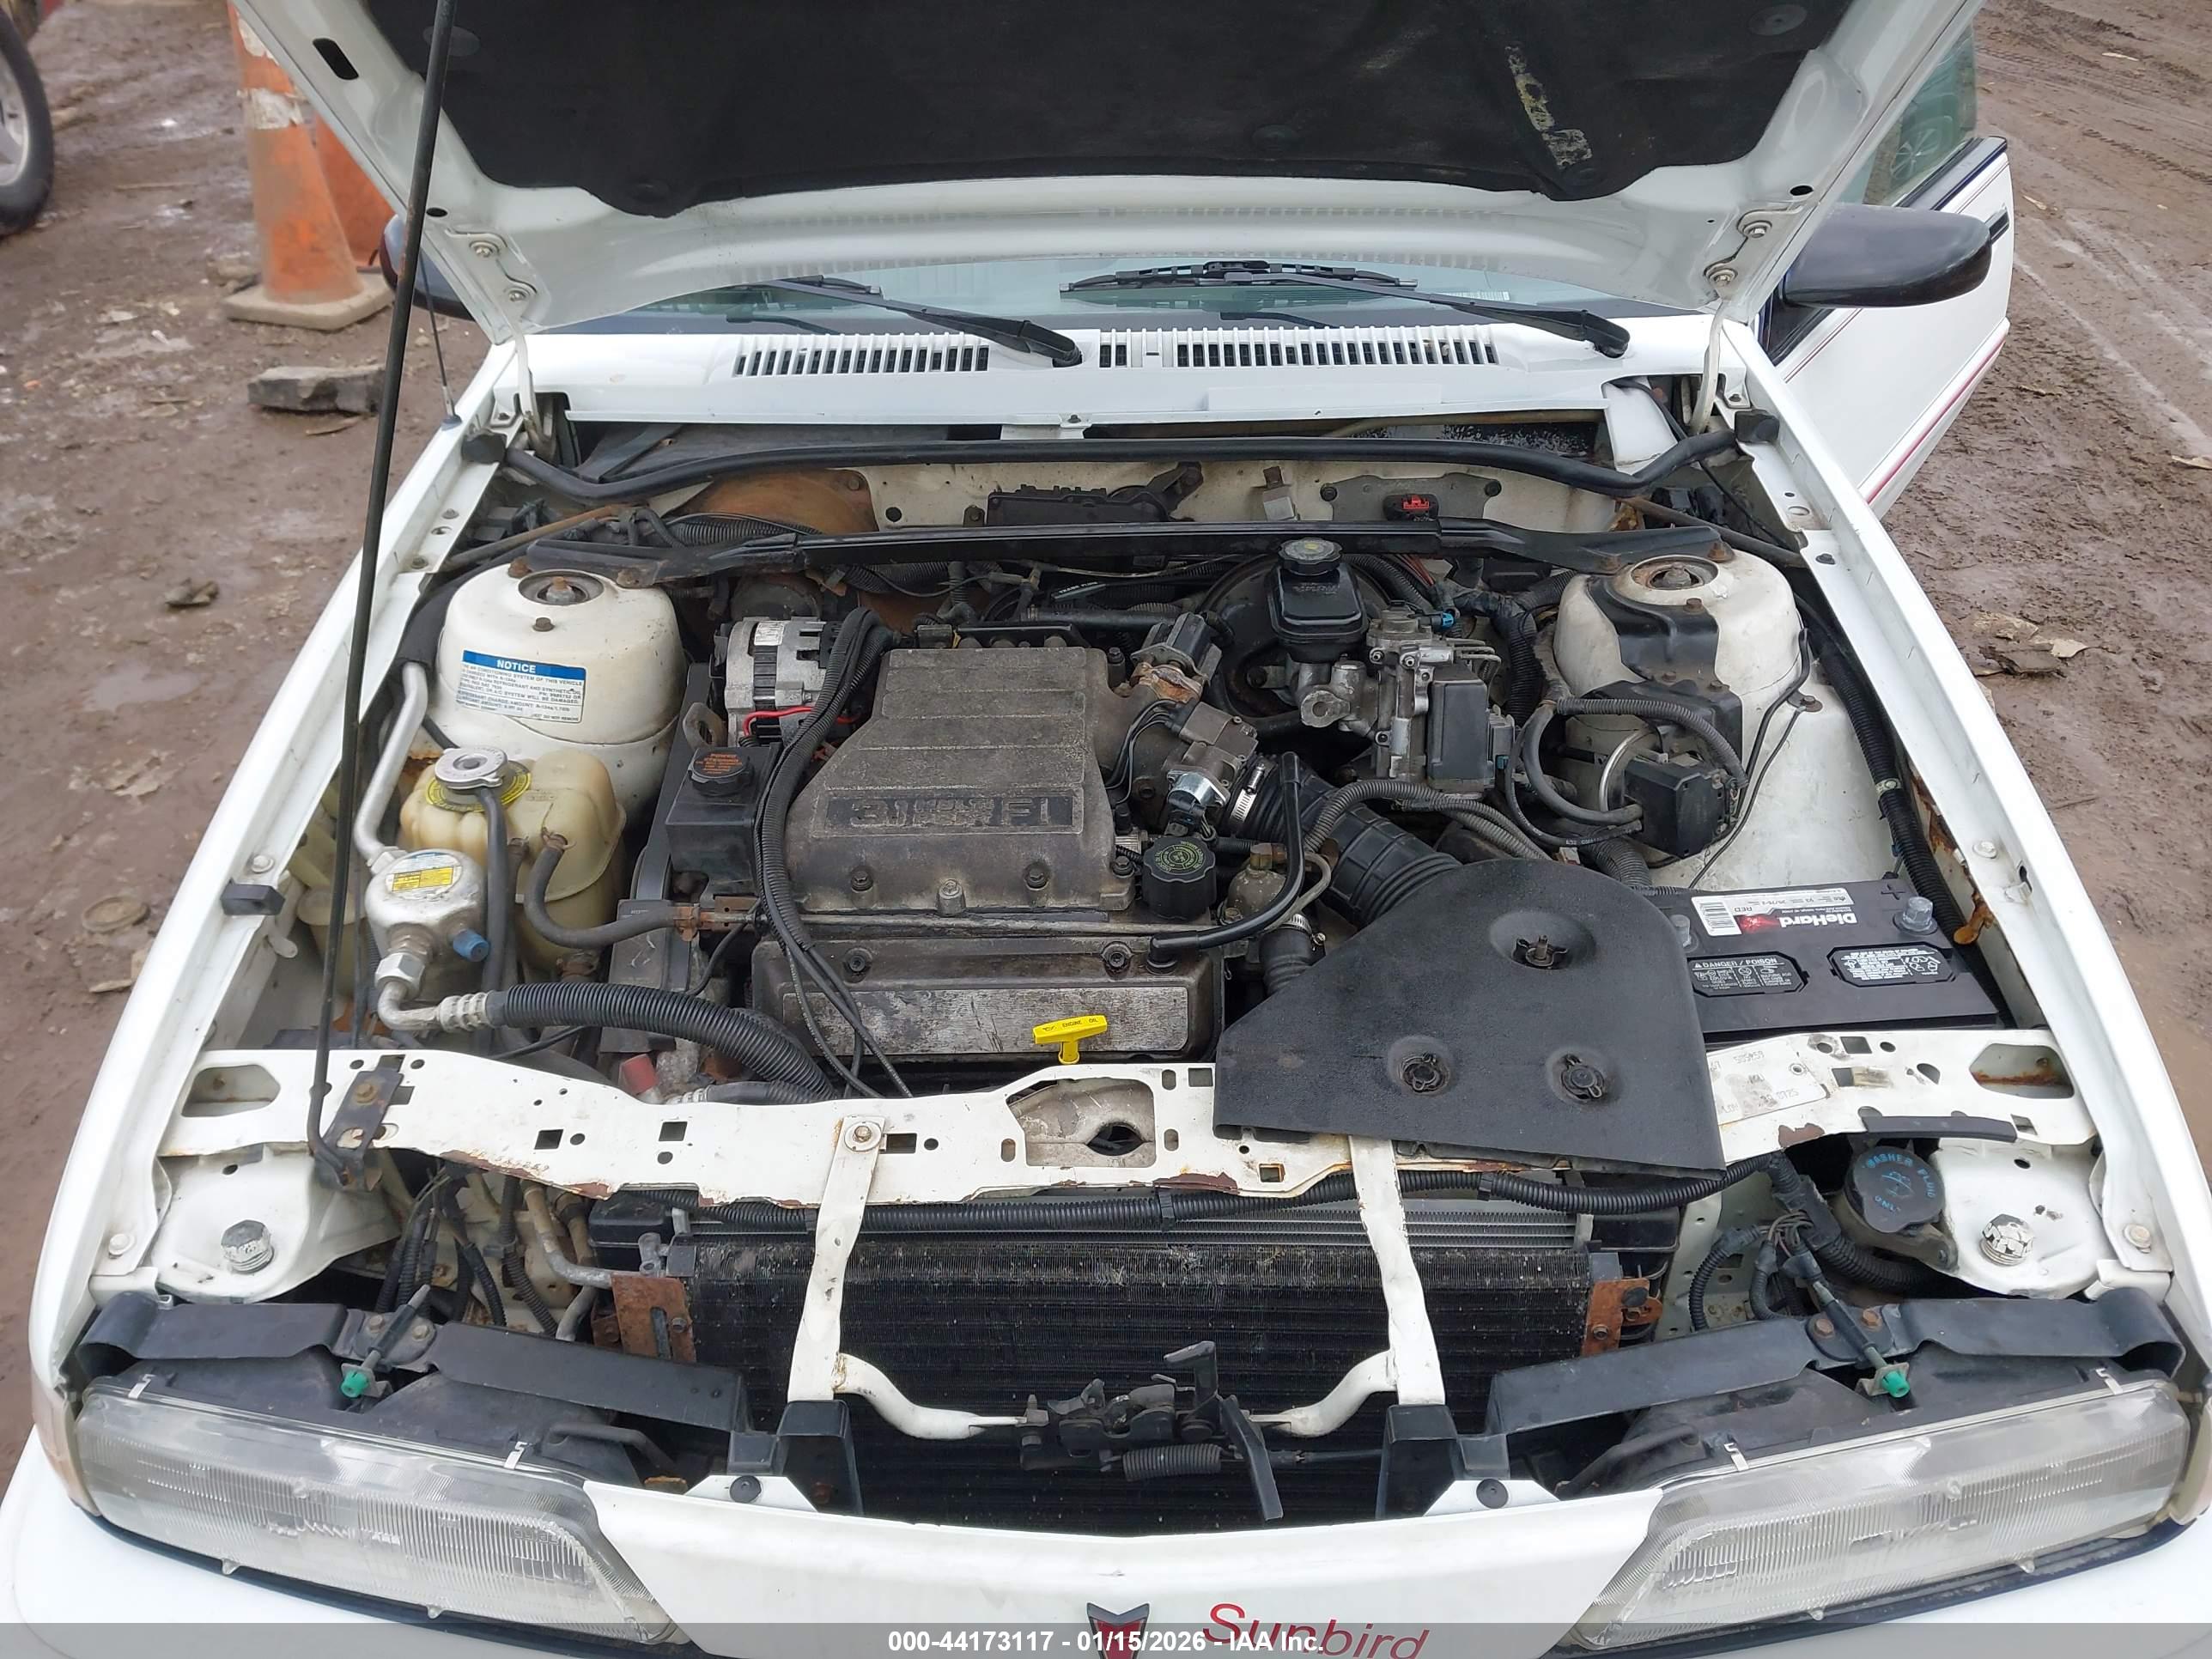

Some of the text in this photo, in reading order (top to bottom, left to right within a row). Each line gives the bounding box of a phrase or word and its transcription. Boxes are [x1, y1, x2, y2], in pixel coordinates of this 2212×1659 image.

[496, 659, 536, 673] NOTICE
[1778, 913, 1857, 928] DieHard
[1202, 1602, 1430, 1659] Sunbird
